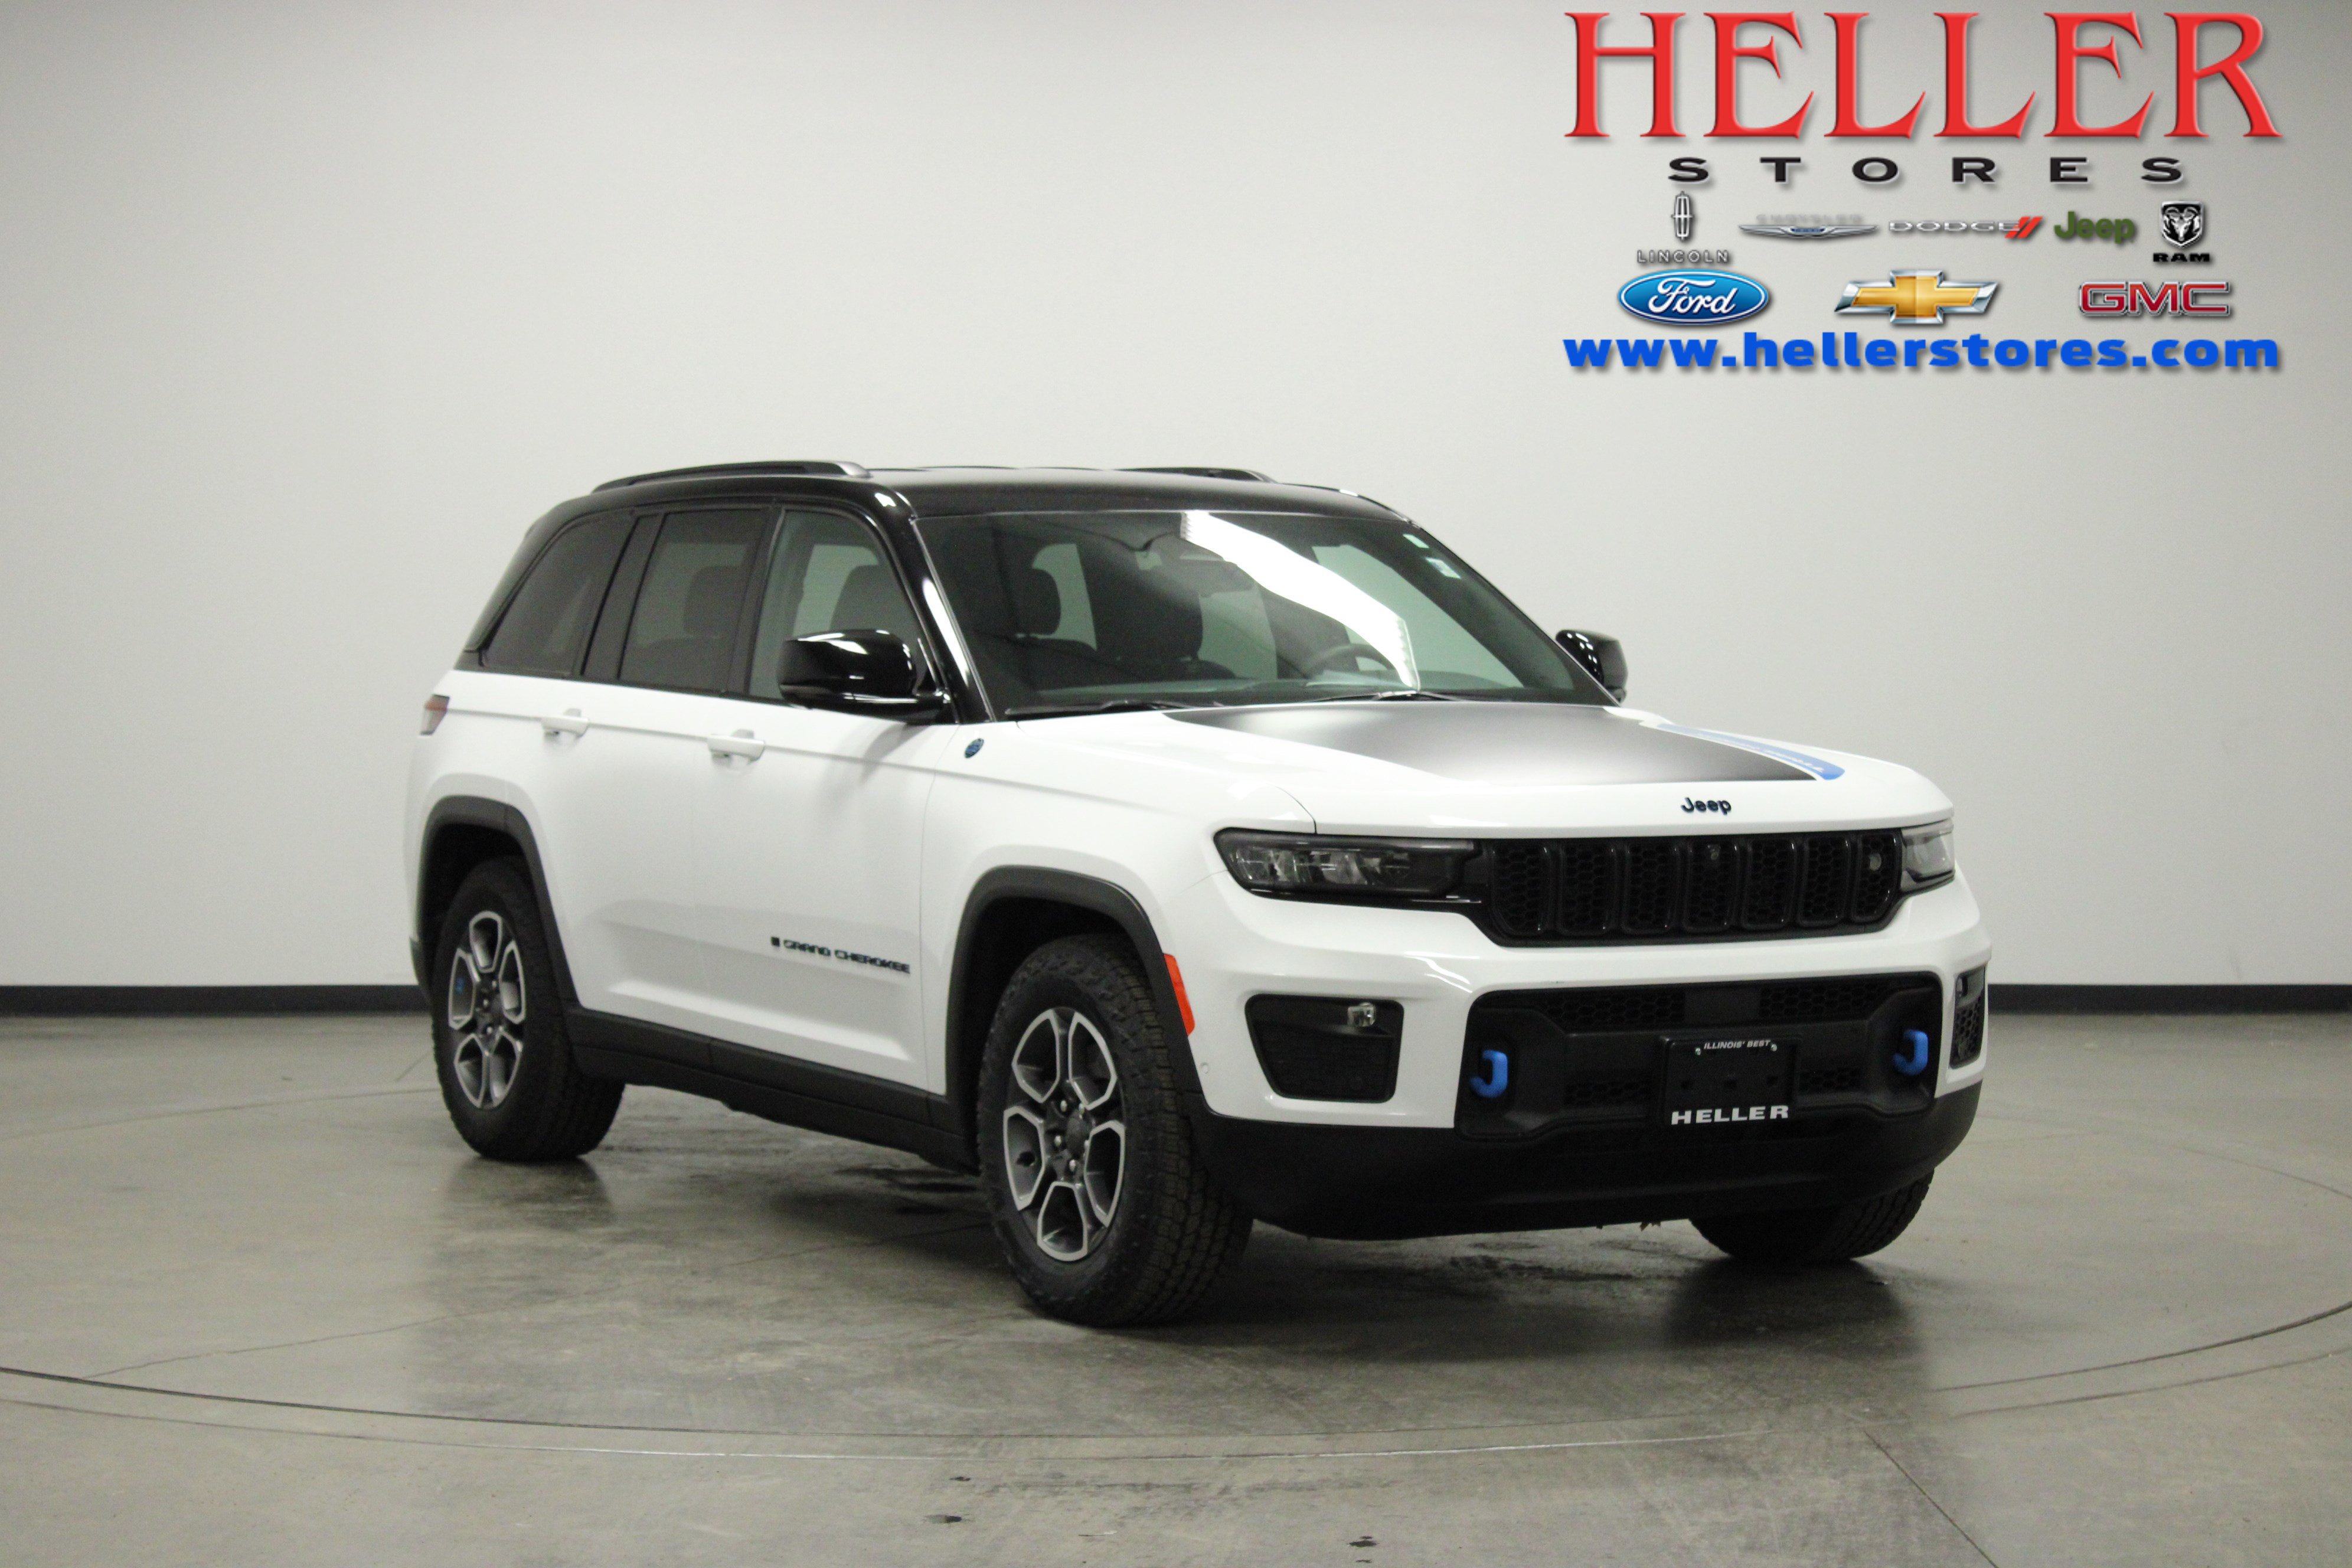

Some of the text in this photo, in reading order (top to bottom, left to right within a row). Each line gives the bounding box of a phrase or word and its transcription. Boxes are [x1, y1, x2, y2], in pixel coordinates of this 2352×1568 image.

[1681, 797, 1731, 815] Jeep
[1747, 1039, 1770, 1048] BEST
[1671, 1105, 1789, 1125] HELLER
